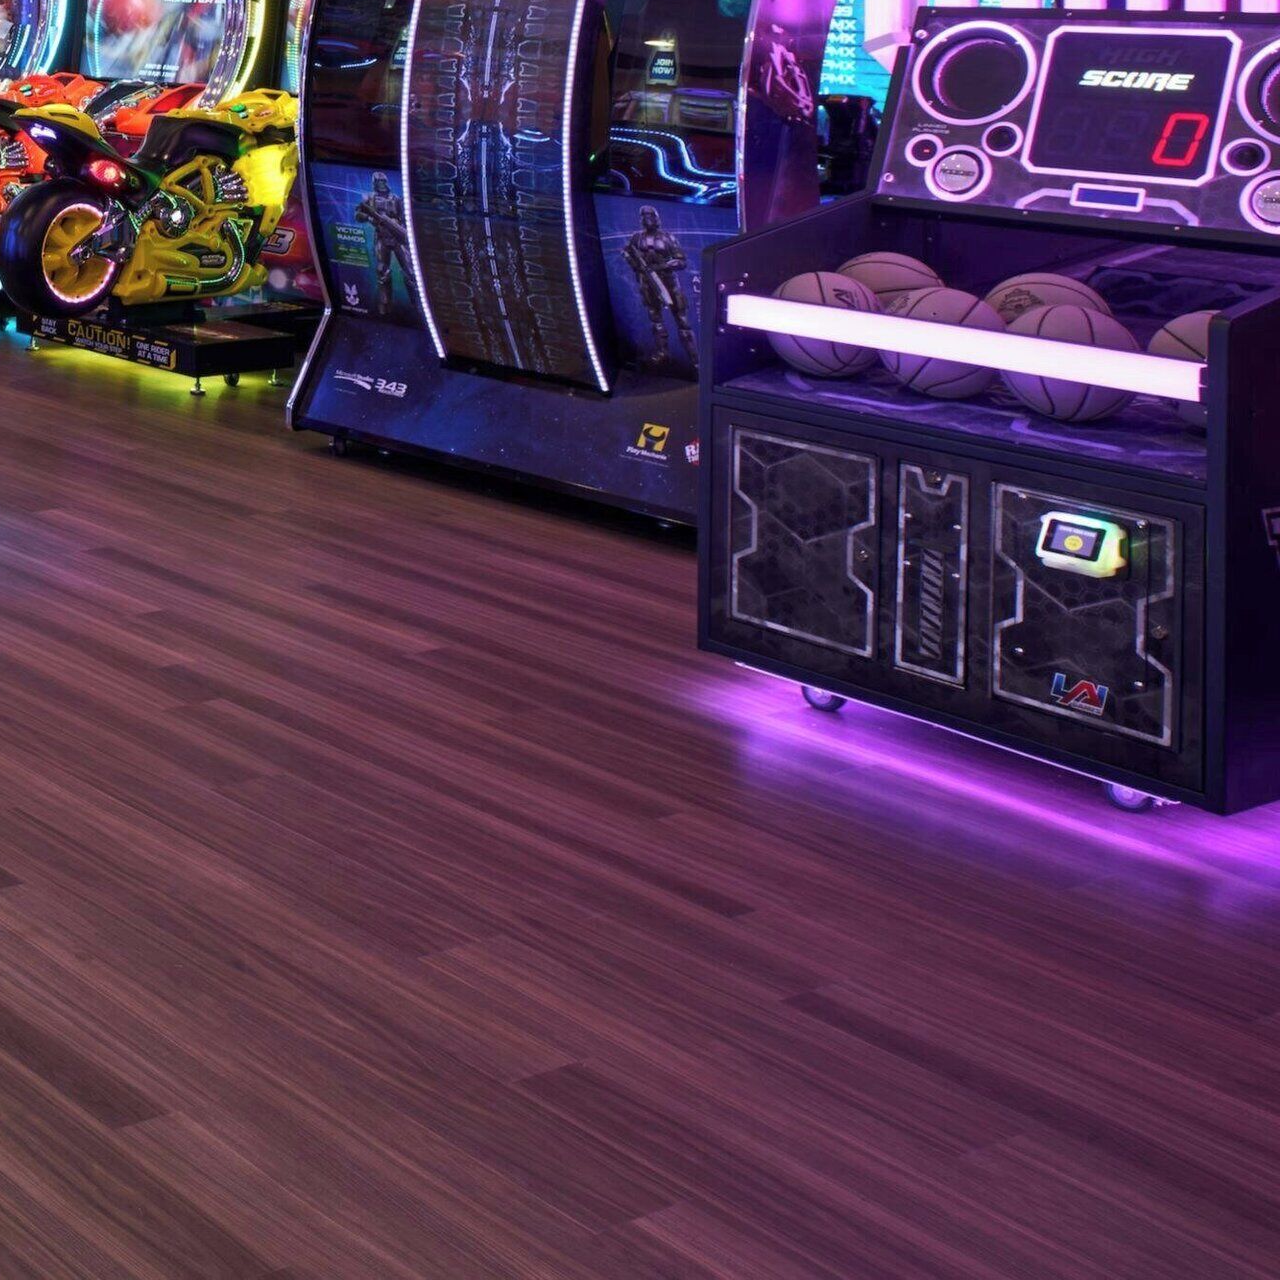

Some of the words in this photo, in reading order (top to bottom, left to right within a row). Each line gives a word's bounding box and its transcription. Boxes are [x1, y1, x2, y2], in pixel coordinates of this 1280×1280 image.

[1079, 70, 1195, 91] SCORE
[1152, 112, 1210, 167] 0
[67, 321, 131, 350] CAUTION!
[136, 341, 149, 351] ONE
[151, 344, 171, 356] RIDER
[137, 350, 146, 358] AT
[153, 354, 169, 364] TIME
[374, 378, 408, 394] 343
